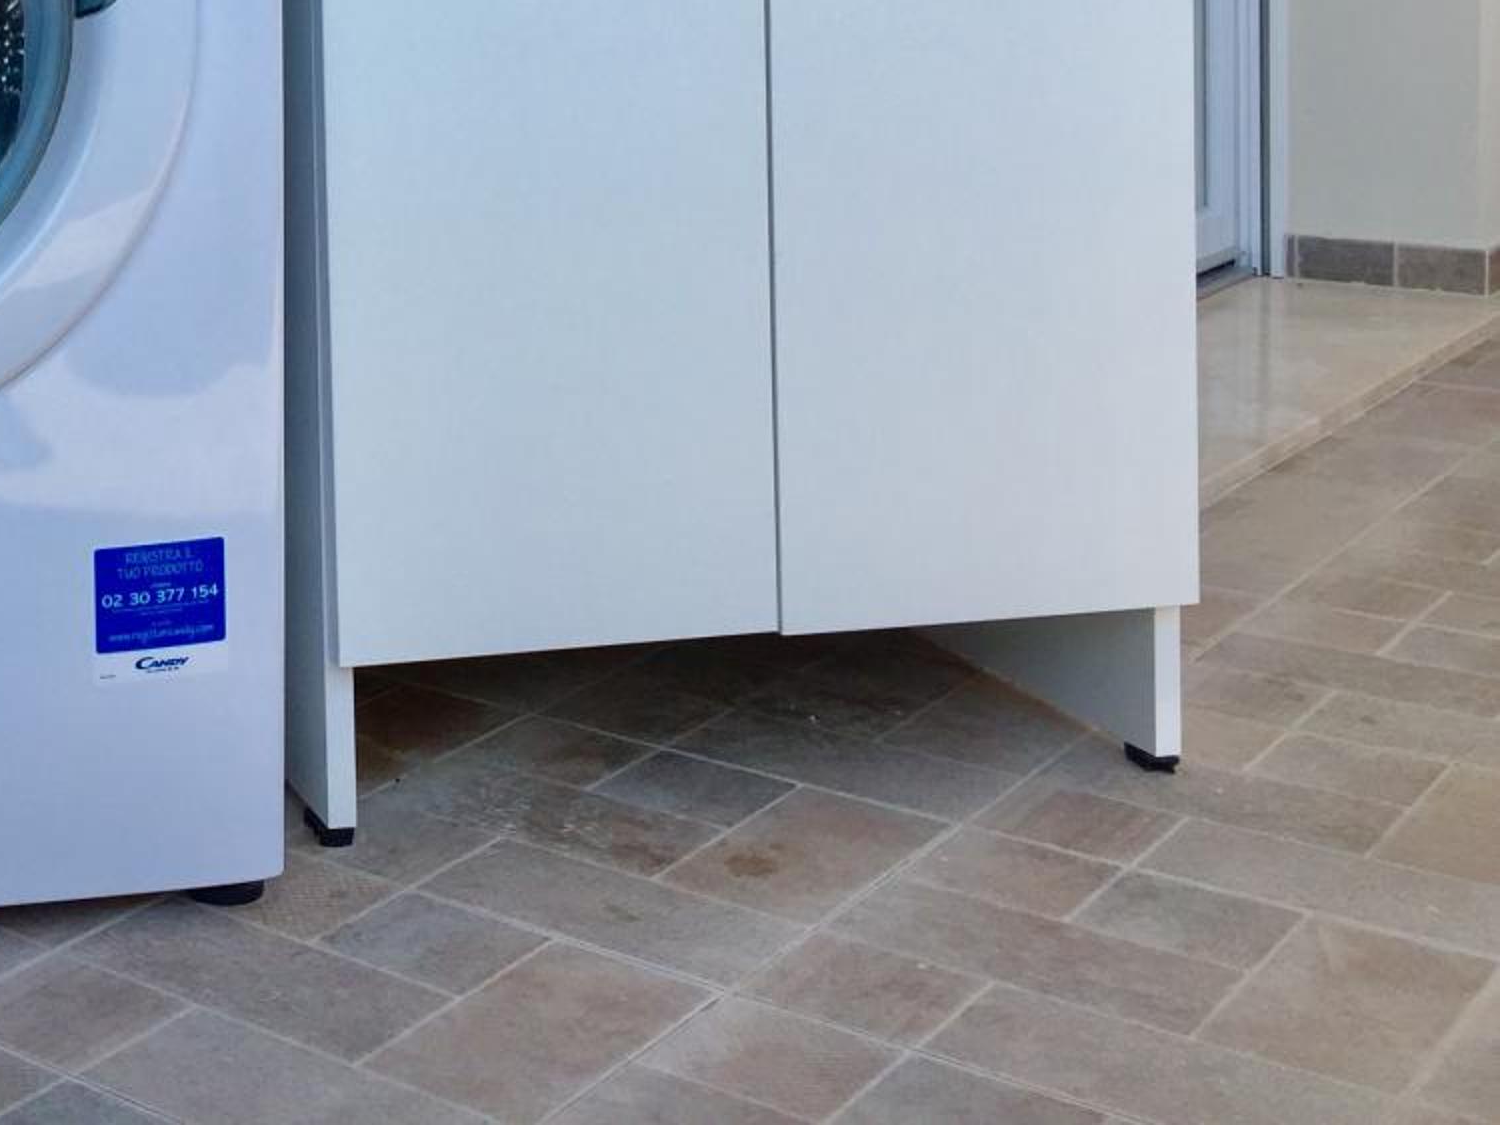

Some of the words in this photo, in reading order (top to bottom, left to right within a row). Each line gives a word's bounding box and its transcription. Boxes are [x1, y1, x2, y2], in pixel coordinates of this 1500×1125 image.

[101, 594, 124, 609] 02
[129, 591, 151, 606] 30
[155, 586, 185, 604] 377
[191, 582, 219, 600] 154
[135, 656, 190, 671] CANDY
